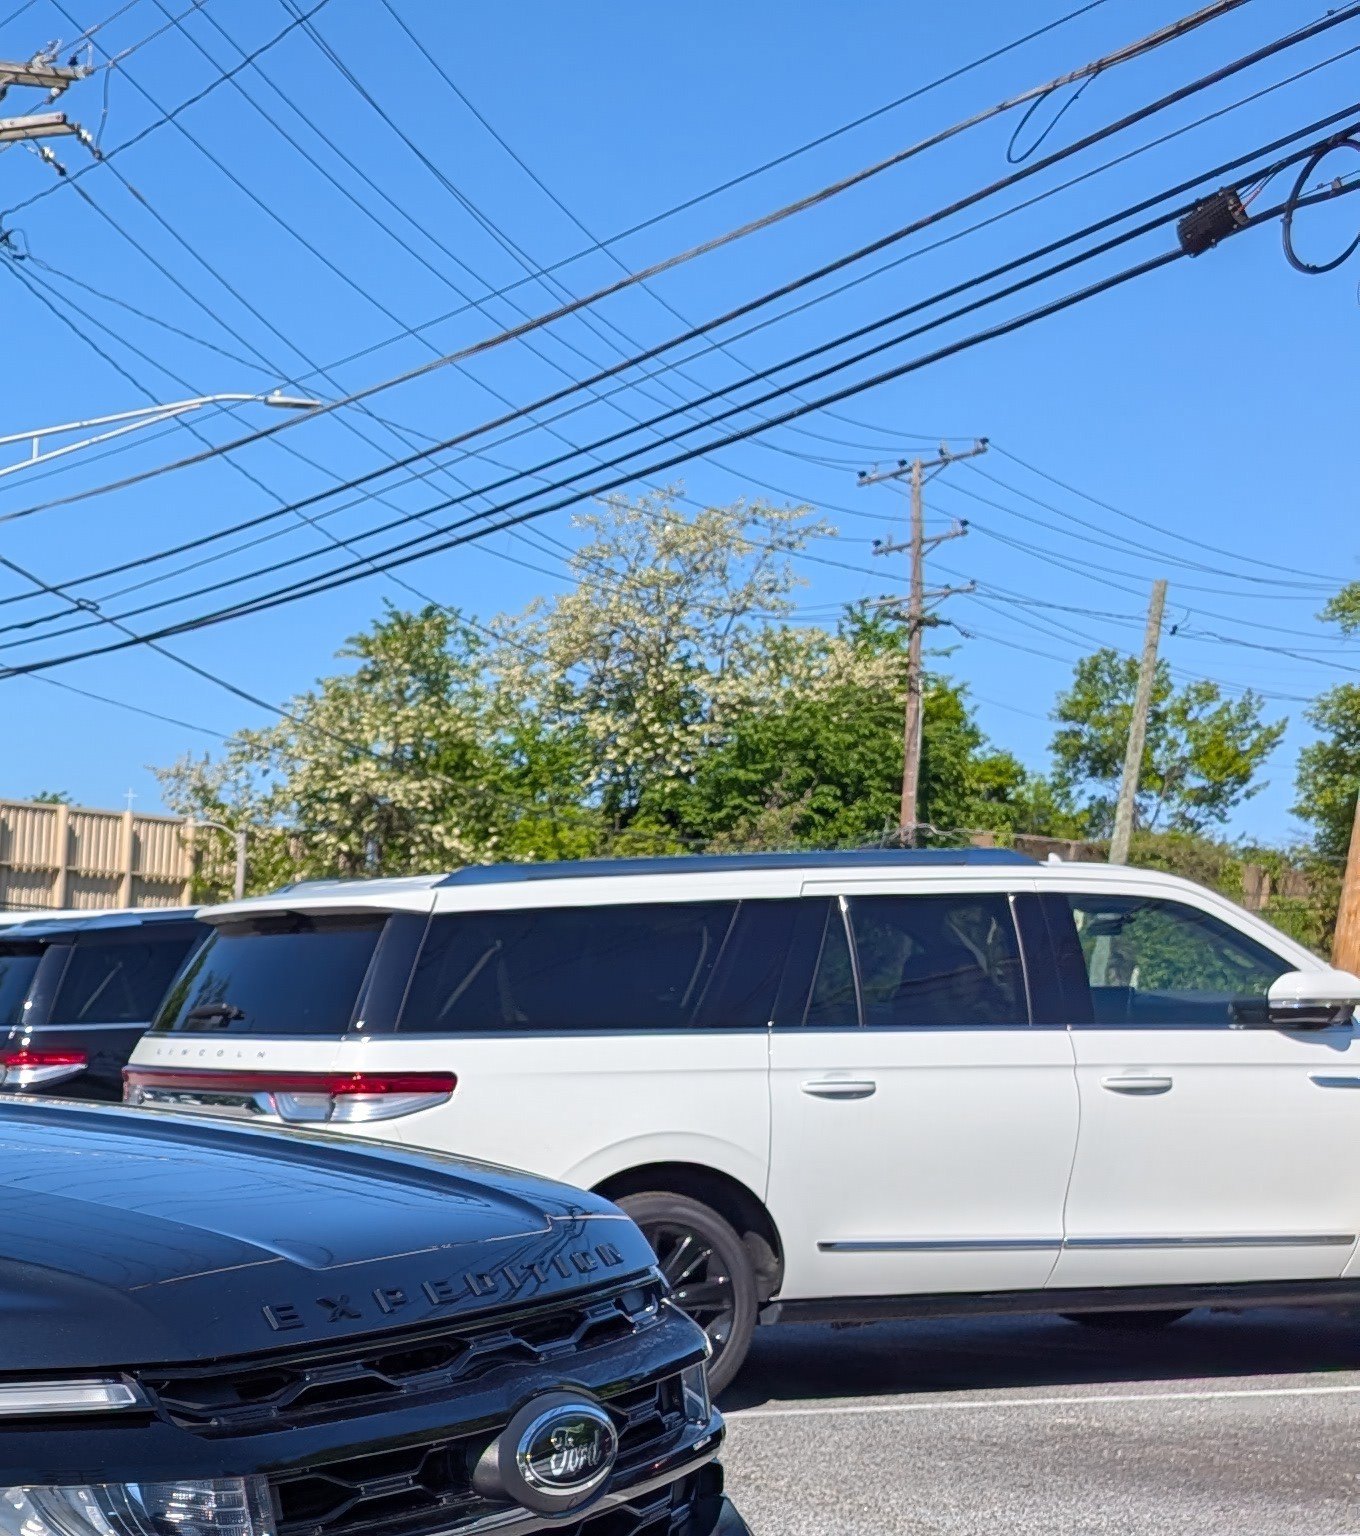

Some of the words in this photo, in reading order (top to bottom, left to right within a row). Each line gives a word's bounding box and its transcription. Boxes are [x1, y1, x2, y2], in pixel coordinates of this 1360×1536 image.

[156, 1047, 266, 1059] LINCOLN
[261, 1243, 625, 1331] EXPEDITION
[549, 1422, 602, 1477] Ford
